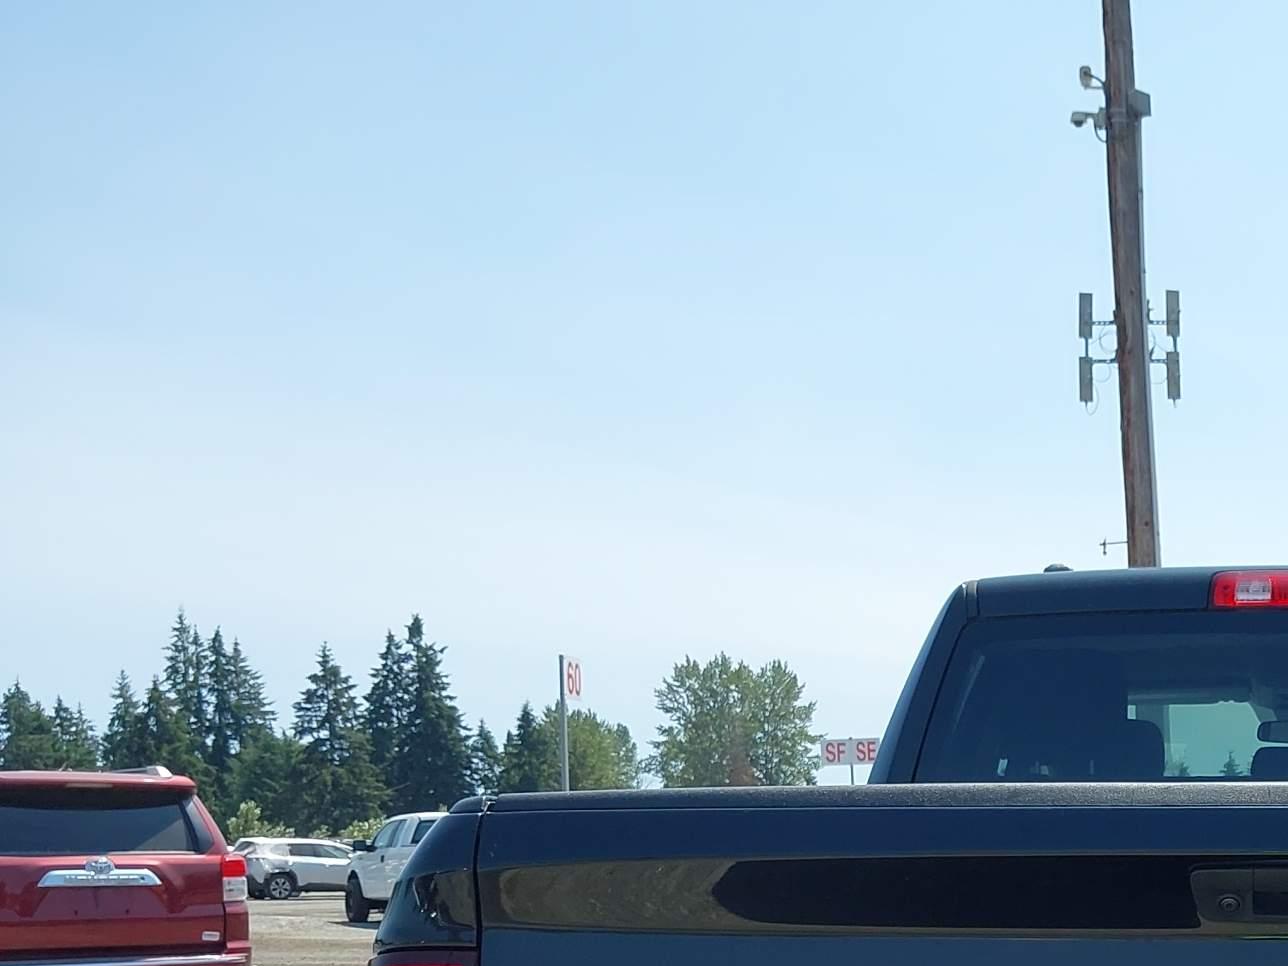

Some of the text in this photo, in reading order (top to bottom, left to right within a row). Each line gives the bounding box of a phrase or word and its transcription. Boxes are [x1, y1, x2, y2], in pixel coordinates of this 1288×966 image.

[567, 661, 581, 696] 60
[826, 741, 876, 762] SF SE
